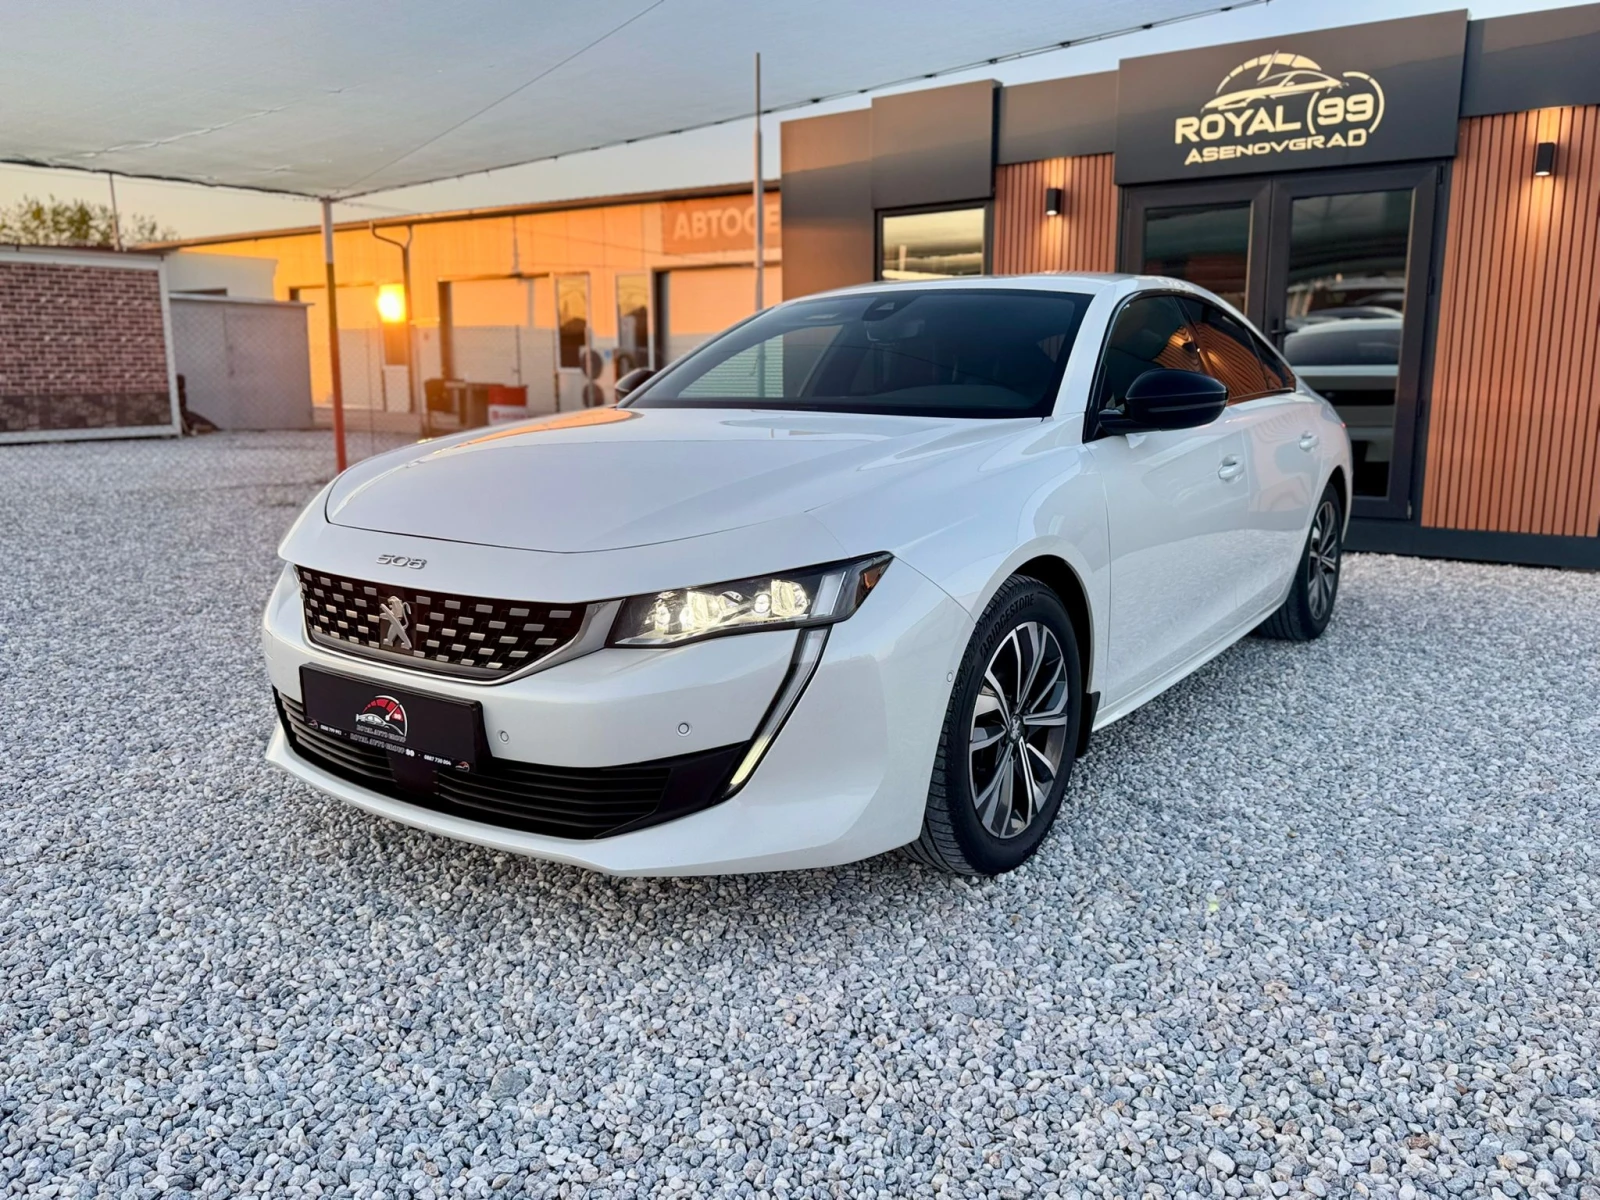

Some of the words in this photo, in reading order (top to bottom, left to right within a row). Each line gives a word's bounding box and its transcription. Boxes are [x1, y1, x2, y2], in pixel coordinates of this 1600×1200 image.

[1174, 104, 1301, 144] ROYAL
[1184, 128, 1367, 165] ASENOVGRAD
[376, 554, 427, 570] 508
[979, 593, 1035, 660] BRIDGESTONE
